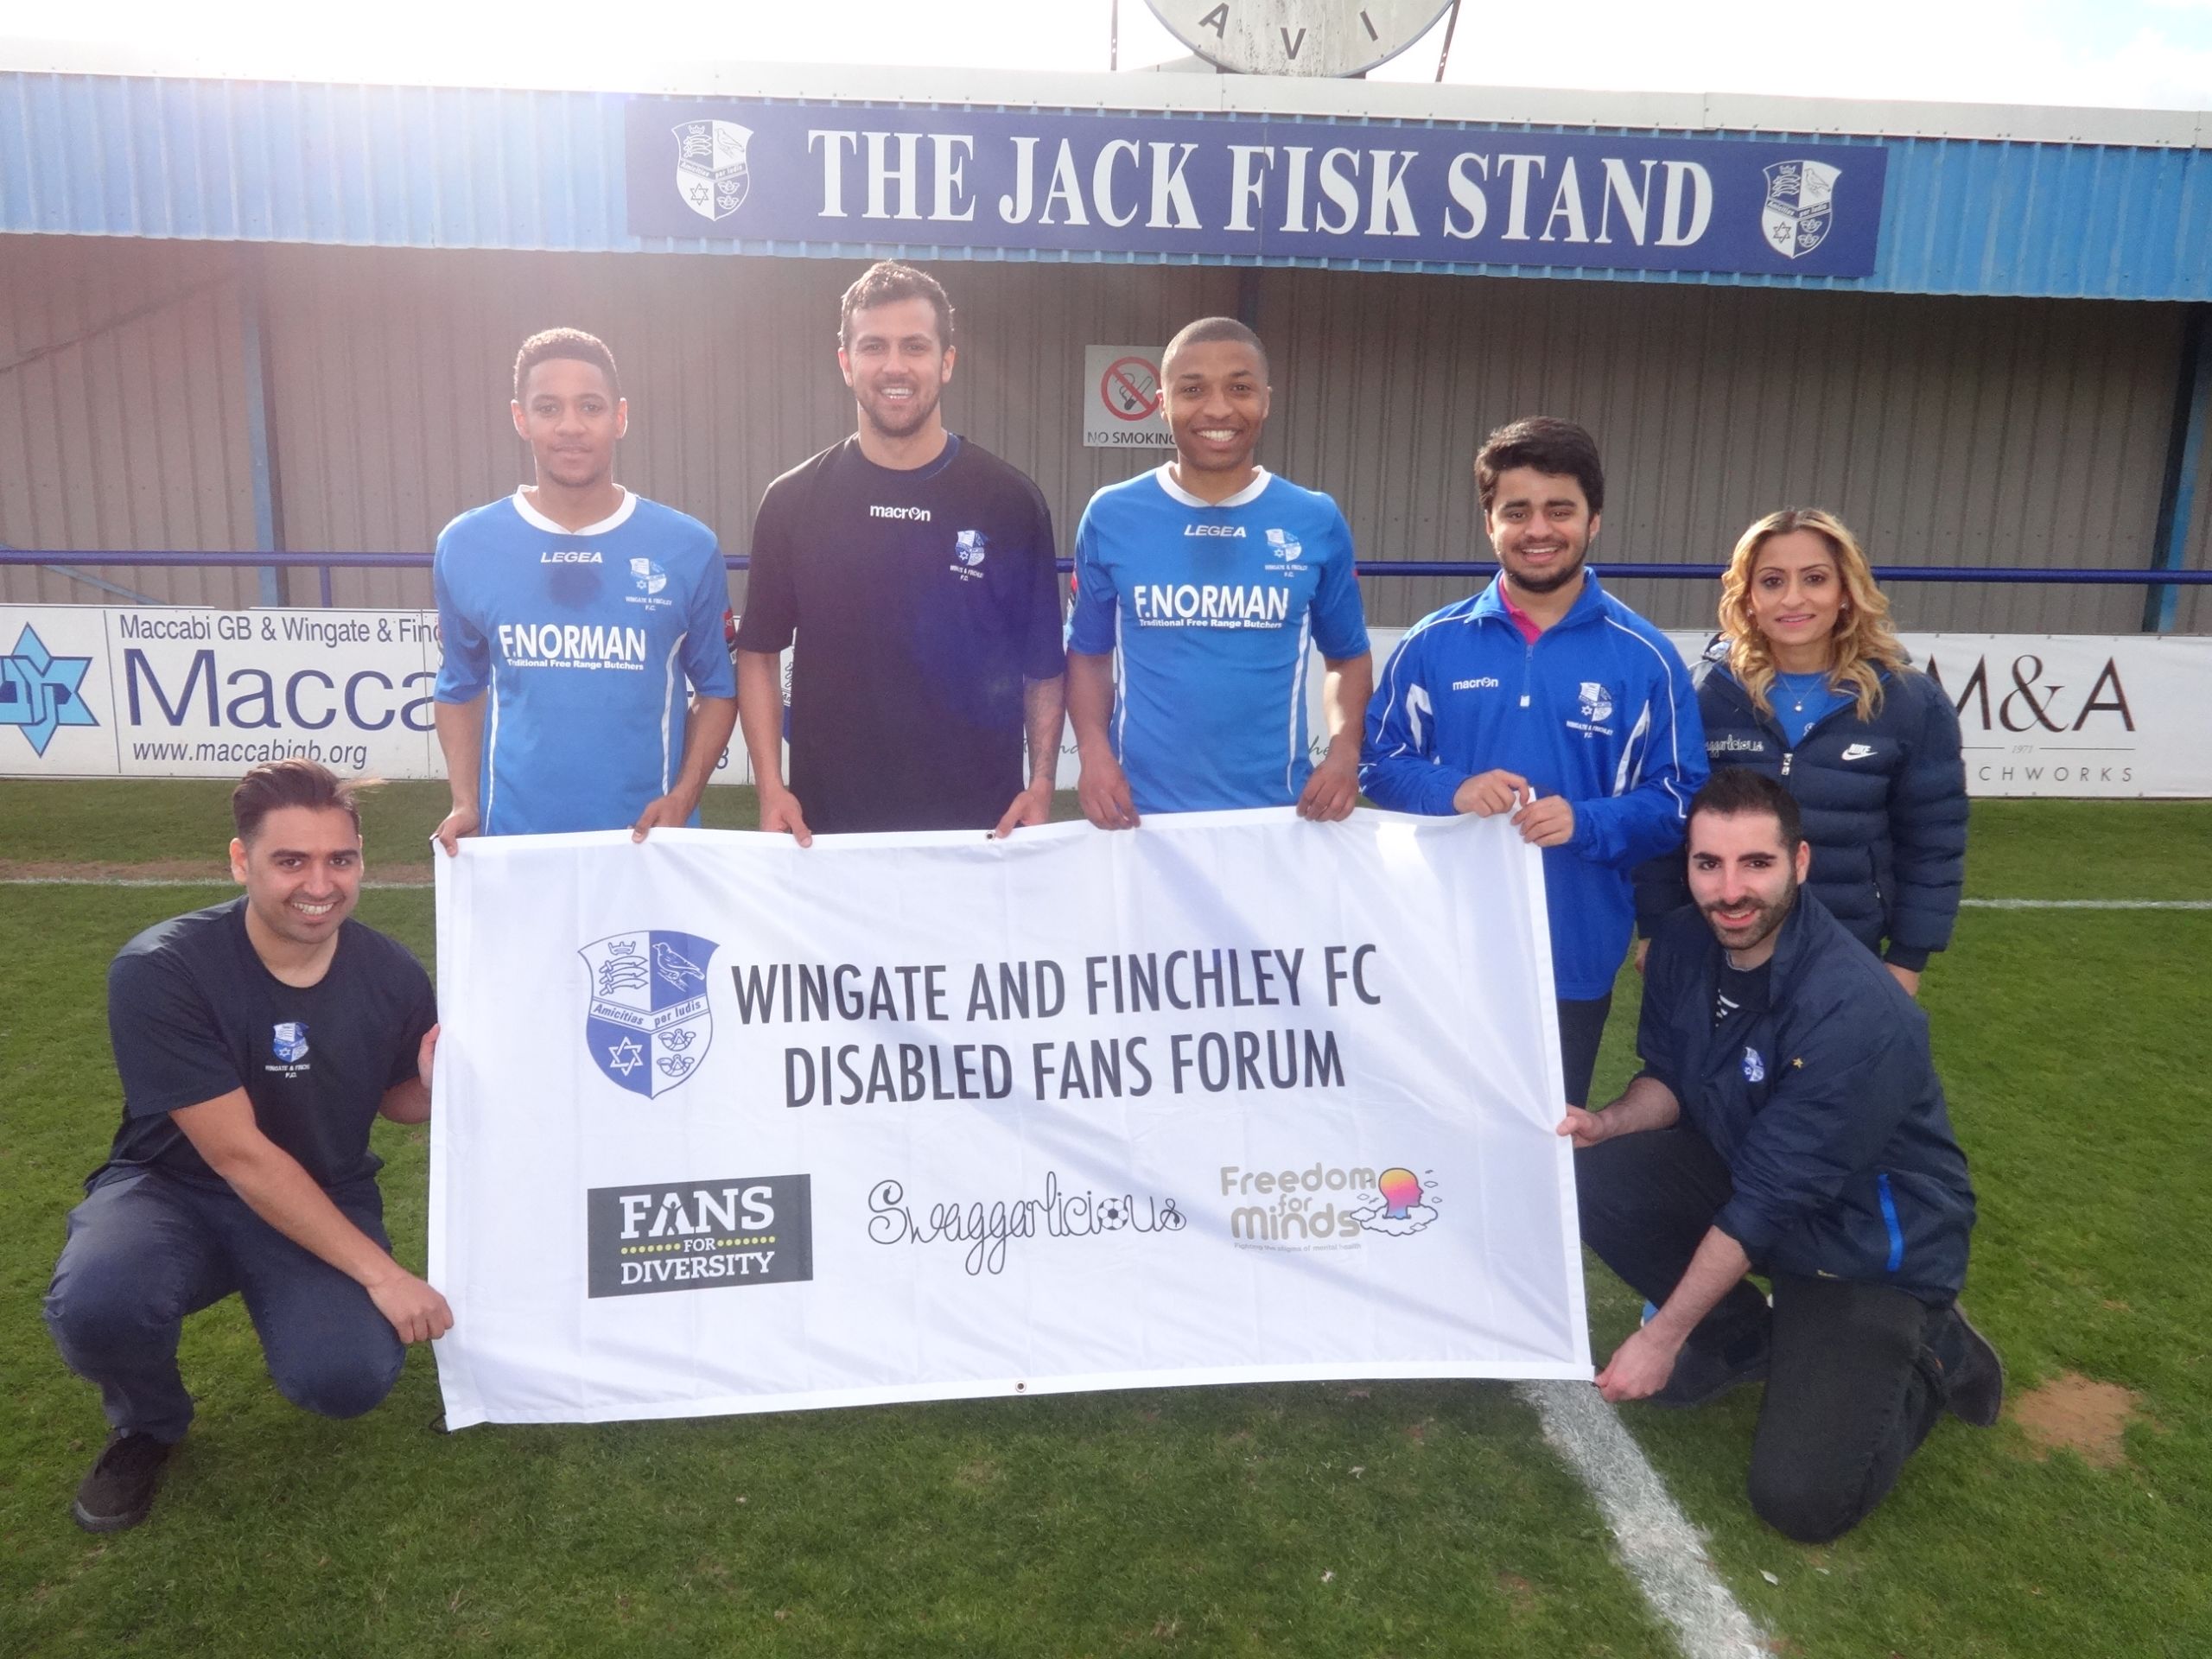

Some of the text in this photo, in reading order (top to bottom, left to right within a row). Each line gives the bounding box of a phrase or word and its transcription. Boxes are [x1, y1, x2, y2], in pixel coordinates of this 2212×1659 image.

[1198, 3, 1230, 40] A
[1280, 27, 1307, 60] V
[807, 130, 1713, 246] THE JACK FISK STAND
[1087, 431, 1109, 443] NO
[870, 505, 931, 522] macron
[1184, 524, 1246, 537] LEGEA
[540, 551, 602, 563] LEGEA
[120, 615, 211, 640] Maccabi
[218, 617, 251, 641] GB
[261, 617, 276, 641] &
[282, 616, 370, 648] Wingate
[378, 619, 393, 642] &
[1211, 620, 1241, 628] Range
[1243, 620, 1282, 628] Butchers
[550, 659, 571, 668] Free
[574, 660, 601, 670] Range
[604, 660, 644, 671] Butchers
[123, 648, 438, 732] Macca
[1452, 677, 1499, 691] macron
[133, 739, 368, 770] www.maccabigb.org
[730, 944, 1382, 1025] WINGATE AND FINCHLEY FC
[593, 1000, 702, 1027] Amicitias per ludis
[784, 1028, 1346, 1109] DISABLED FANS FORUM
[1220, 1162, 1376, 1197] Freedom
[619, 1185, 775, 1239] FANS
[1278, 1193, 1313, 1217] for
[683, 1237, 716, 1253] FOR
[620, 1250, 775, 1285] DIVERSITY
